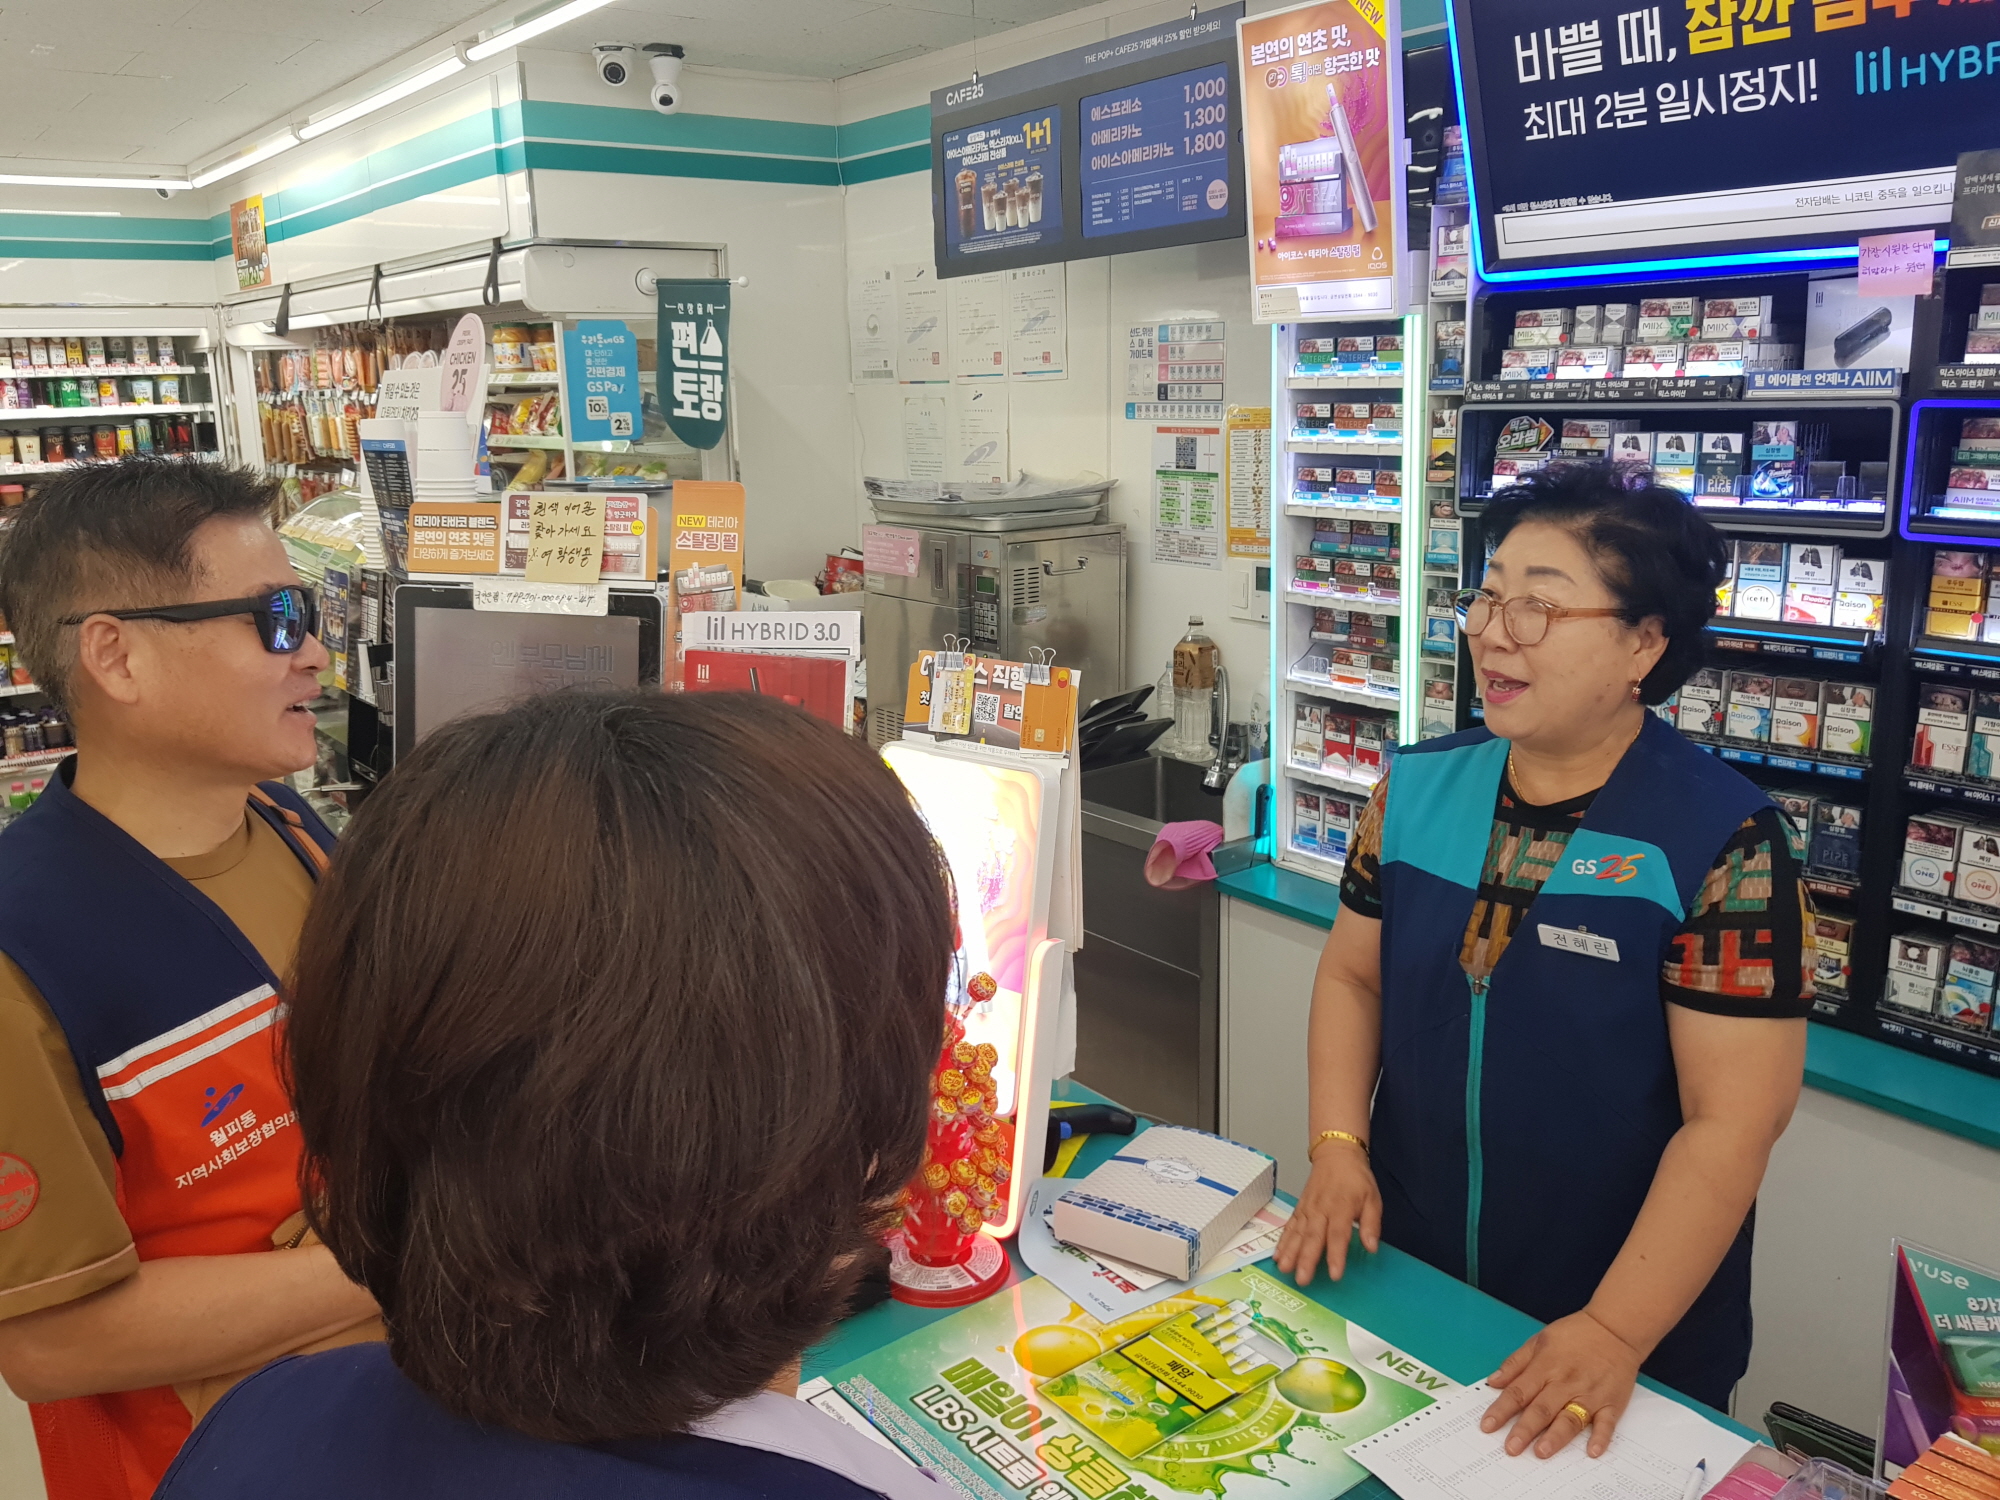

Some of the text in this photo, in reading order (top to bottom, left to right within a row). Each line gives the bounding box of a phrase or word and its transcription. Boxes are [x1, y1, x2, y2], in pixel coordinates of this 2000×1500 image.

[1355, 0, 1383, 25] NEW
[1084, 20, 1221, 64] THE POP+ CAFE25 가입해서 25% 할인 받으세요!
[1251, 24, 1351, 66] 본연의 연초 맛,
[1515, 19, 1603, 84] 바쁠
[1616, 6, 1677, 66] 때,
[1685, 0, 1791, 55] 잠깐
[1308, 64, 1322, 76] 하면
[1324, 51, 1364, 76] 향긋한
[1366, 48, 1381, 68] 맛
[946, 83, 984, 106] CAFE25
[1091, 77, 1226, 122] 에스프레소 1,000
[1524, 96, 1586, 141] 최대
[1595, 87, 1648, 130] 2분
[1656, 58, 1818, 124] 일시정지!
[1856, 46, 1891, 96] lil
[1091, 103, 1226, 146] 아메리카노 1,300
[1023, 117, 1051, 149] 1+1
[1091, 130, 1226, 171] 아이스아메리카노 1,800
[1298, 185, 1338, 203] TEREA
[1963, 185, 1994, 195] 프리미엄
[1795, 192, 1840, 208] 전자담배는
[1845, 190, 1873, 203] 니코틴
[1878, 187, 1907, 201] 중독을
[1278, 244, 1361, 262] 아이코스 테리아 스탈링 펄
[1912, 242, 1933, 254] 담배
[1368, 262, 1388, 270] IQOS
[1642, 321, 1664, 331] MIIX
[1706, 323, 1729, 332] MIIX
[581, 333, 625, 348] 우리동네GS
[1517, 331, 1535, 339] MIIX
[449, 352, 477, 365] CHICKEN
[1129, 349, 1153, 359] 가이드북
[1311, 354, 1333, 362] TEREA
[1348, 353, 1371, 361] TEREA
[586, 366, 626, 378] 간편결제
[1504, 370, 1523, 378] MIIX
[1755, 370, 1893, 387] 릴 에이블엔 언제나 AIIM
[1940, 368, 1975, 377] 믹스 아이스
[587, 381, 603, 392] GS
[1942, 380, 1985, 388] 믹스 프렌치
[1307, 420, 1328, 428] TEREA
[1345, 420, 1367, 428] TEREA
[1510, 417, 1531, 431] 믹스
[1499, 428, 1539, 449] 오라썸
[1309, 483, 1329, 491] TEREA
[564, 501, 597, 517] 이어폰
[613, 510, 637, 519] 향긋하게
[414, 515, 441, 527] 테리아
[441, 515, 468, 528] 타바코
[468, 516, 497, 529] 블렌드,
[679, 516, 738, 529] NEW 테리아
[413, 530, 495, 547] 본연의 연초 맛을
[676, 531, 738, 552] 스탈링 펄
[413, 547, 495, 561] 다양하게 즐겨보세요
[1746, 595, 1769, 604] ice fit
[1839, 599, 1867, 610] Raison
[707, 616, 841, 641] lil HYBRID 3.0
[520, 642, 613, 672] 부모님께
[697, 664, 710, 679] lil
[1333, 668, 1356, 676] HEETS
[1373, 674, 1395, 682] HEETS
[1682, 705, 1707, 715] Raison
[1731, 711, 1755, 721] Raison
[1776, 717, 1802, 727] Raison
[1827, 725, 1854, 735] Raison
[1942, 743, 1961, 752] ESSE
[1572, 853, 1645, 884] GS25
[1915, 869, 1935, 879] ONE
[1971, 881, 1992, 891] ONE
[209, 1109, 258, 1148] 월피동
[1934, 1314, 1953, 1330] 더
[1134, 1352, 1204, 1401] 금연상담전화 1544-9030
[1166, 1360, 1195, 1379] 폐암
[1375, 1350, 1449, 1391] NEW
[939, 1356, 1058, 1442] 매일이
[910, 1385, 978, 1433] LBS
[957, 1425, 1047, 1490] 시트로
